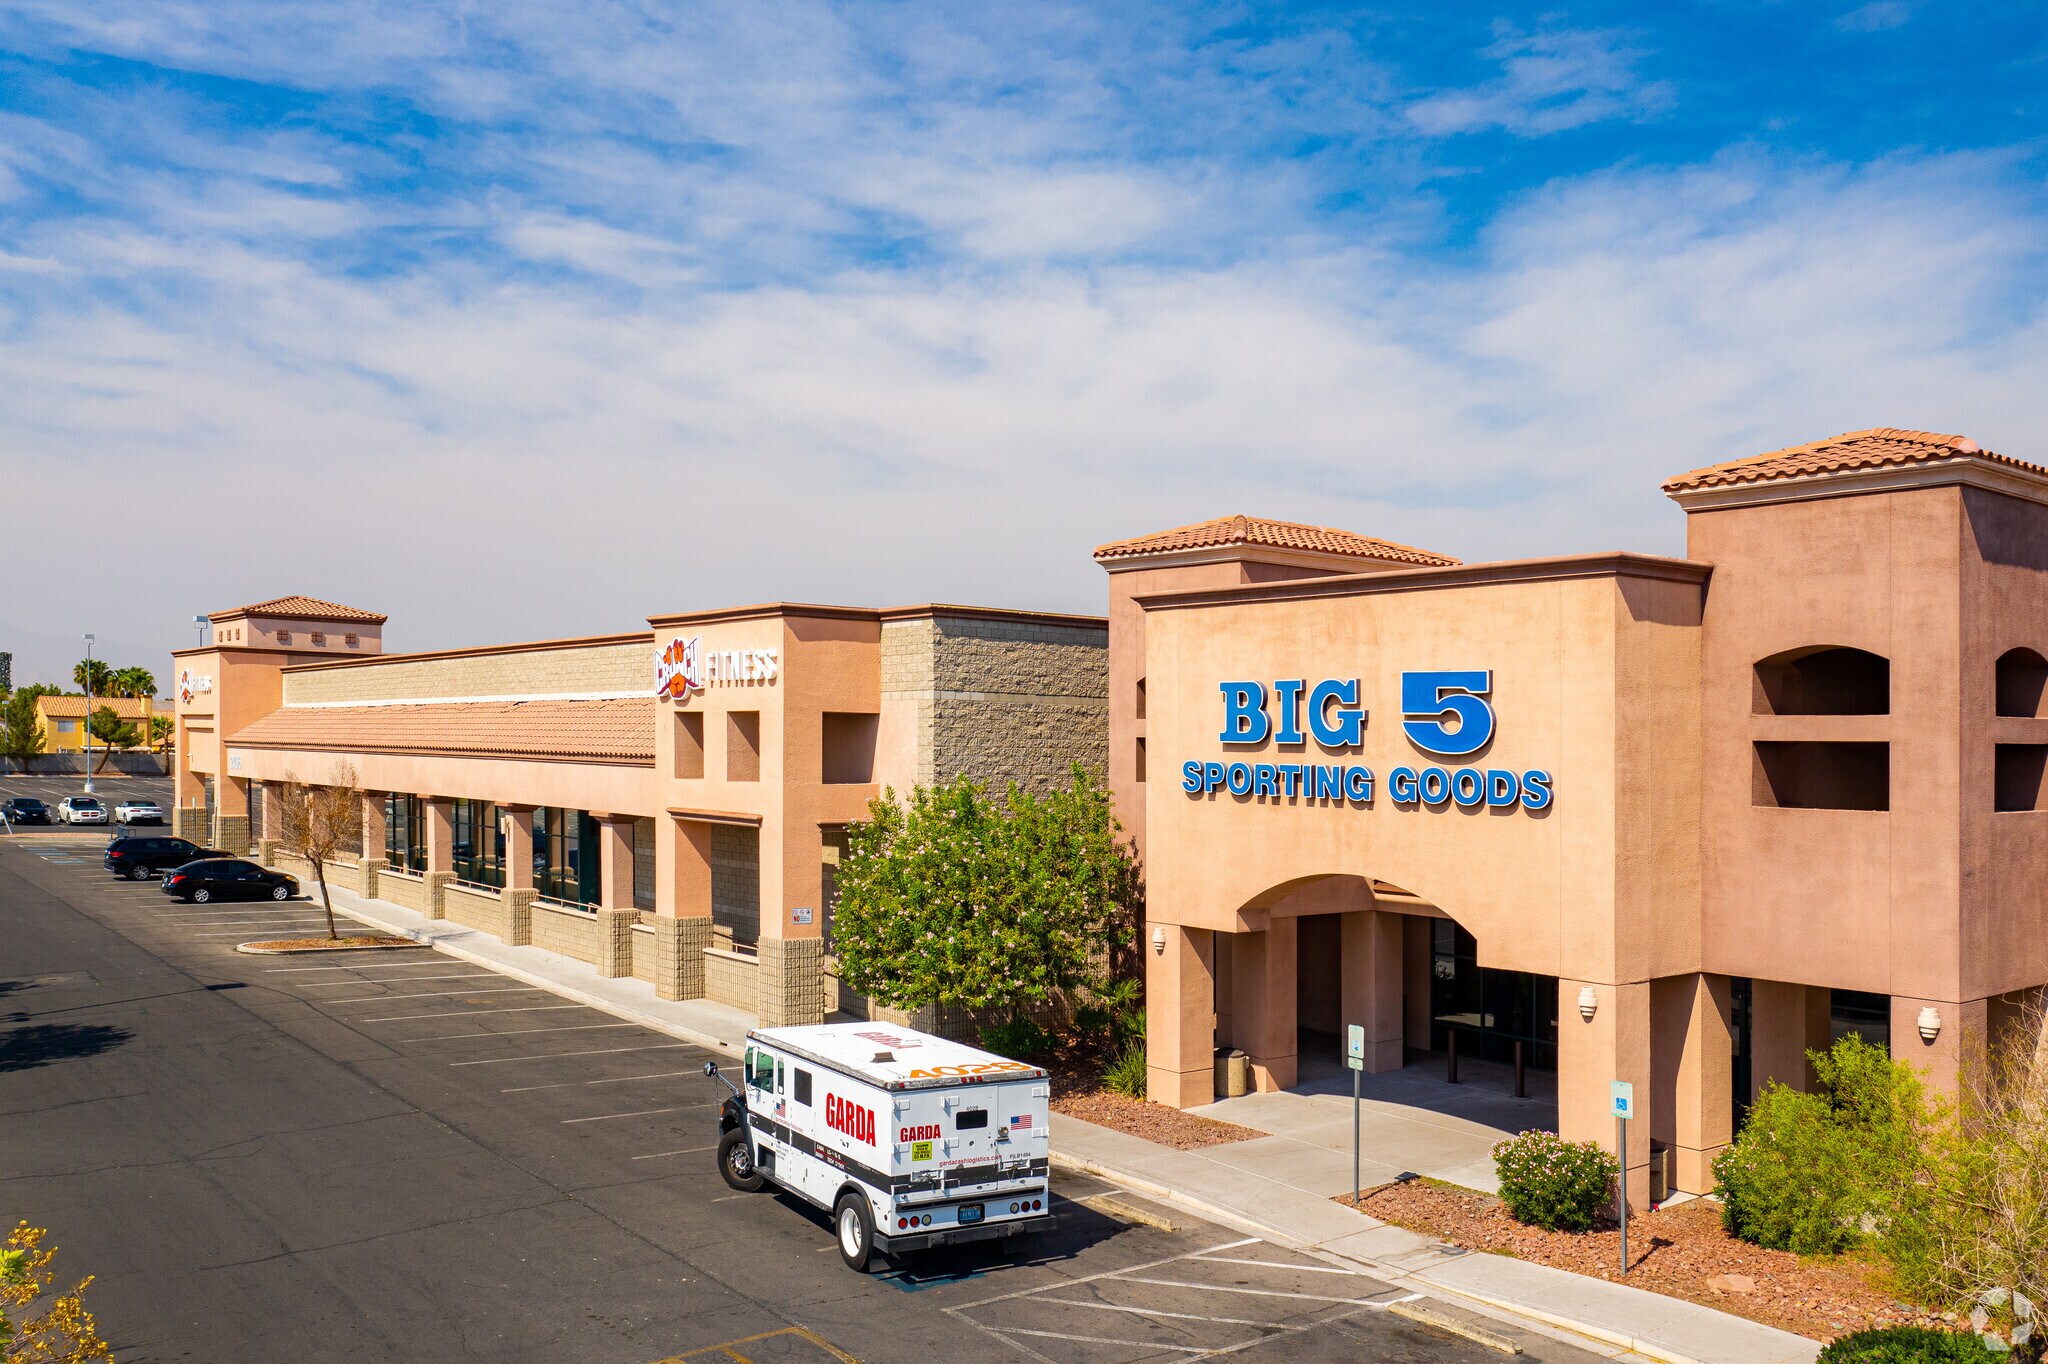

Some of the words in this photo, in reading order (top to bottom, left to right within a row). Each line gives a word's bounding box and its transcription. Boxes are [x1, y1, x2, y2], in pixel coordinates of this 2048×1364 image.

[706, 649, 778, 681] FITNESS
[1219, 678, 1366, 749] BIG
[1400, 669, 1496, 755] 5
[1181, 759, 1375, 803] SPORTING
[1388, 765, 1553, 811] GOODS
[910, 1062, 1031, 1079] 4028
[826, 1092, 876, 1148] GARDA
[900, 1124, 941, 1142] GARDA
[939, 1154, 1002, 1168] gardacashlogistics.com
